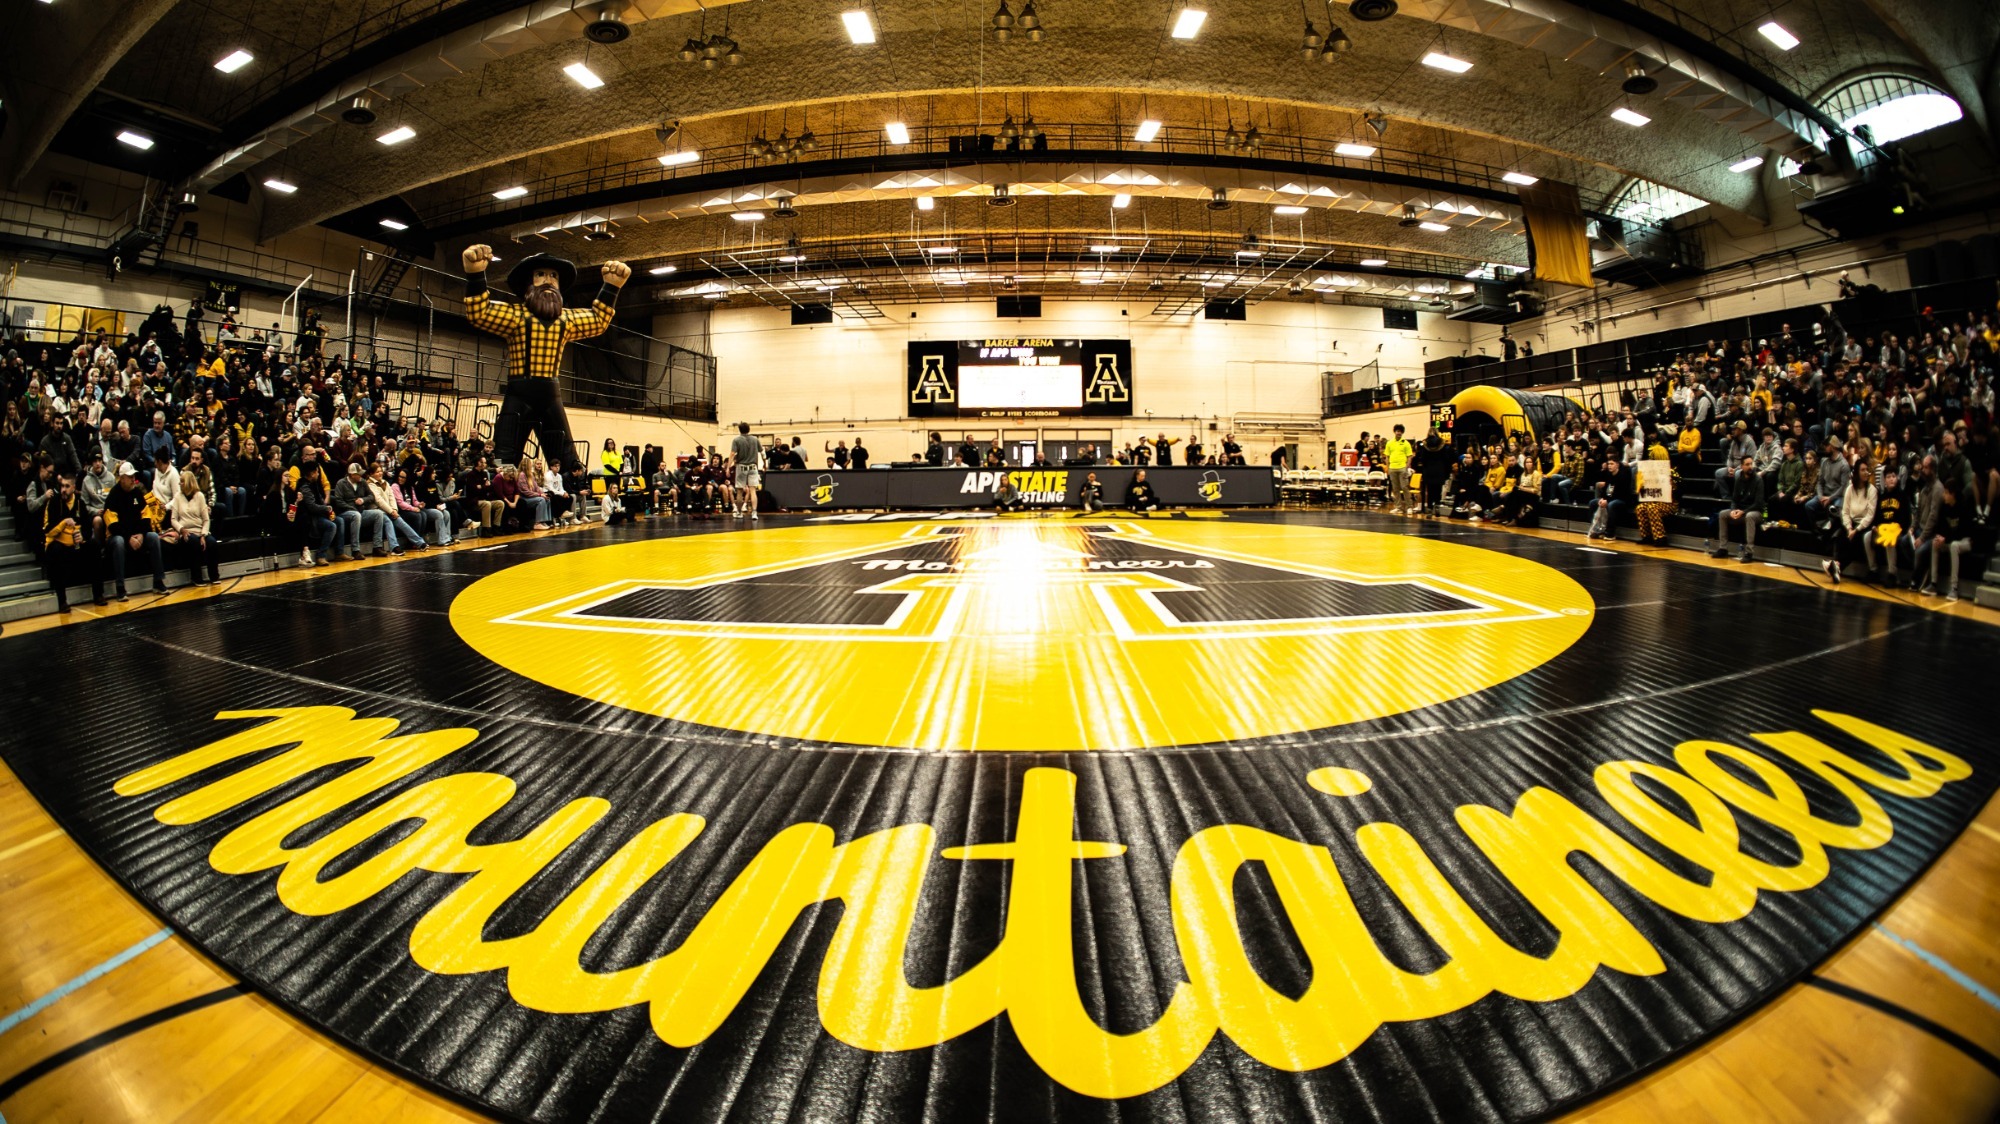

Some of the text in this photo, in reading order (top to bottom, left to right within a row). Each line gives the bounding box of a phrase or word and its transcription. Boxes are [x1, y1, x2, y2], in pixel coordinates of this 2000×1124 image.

[984, 339, 1054, 348] BARKER ARENA
[912, 355, 955, 403] A
[1085, 354, 1129, 402] A
[112, 704, 1972, 1099] Mountaineers
